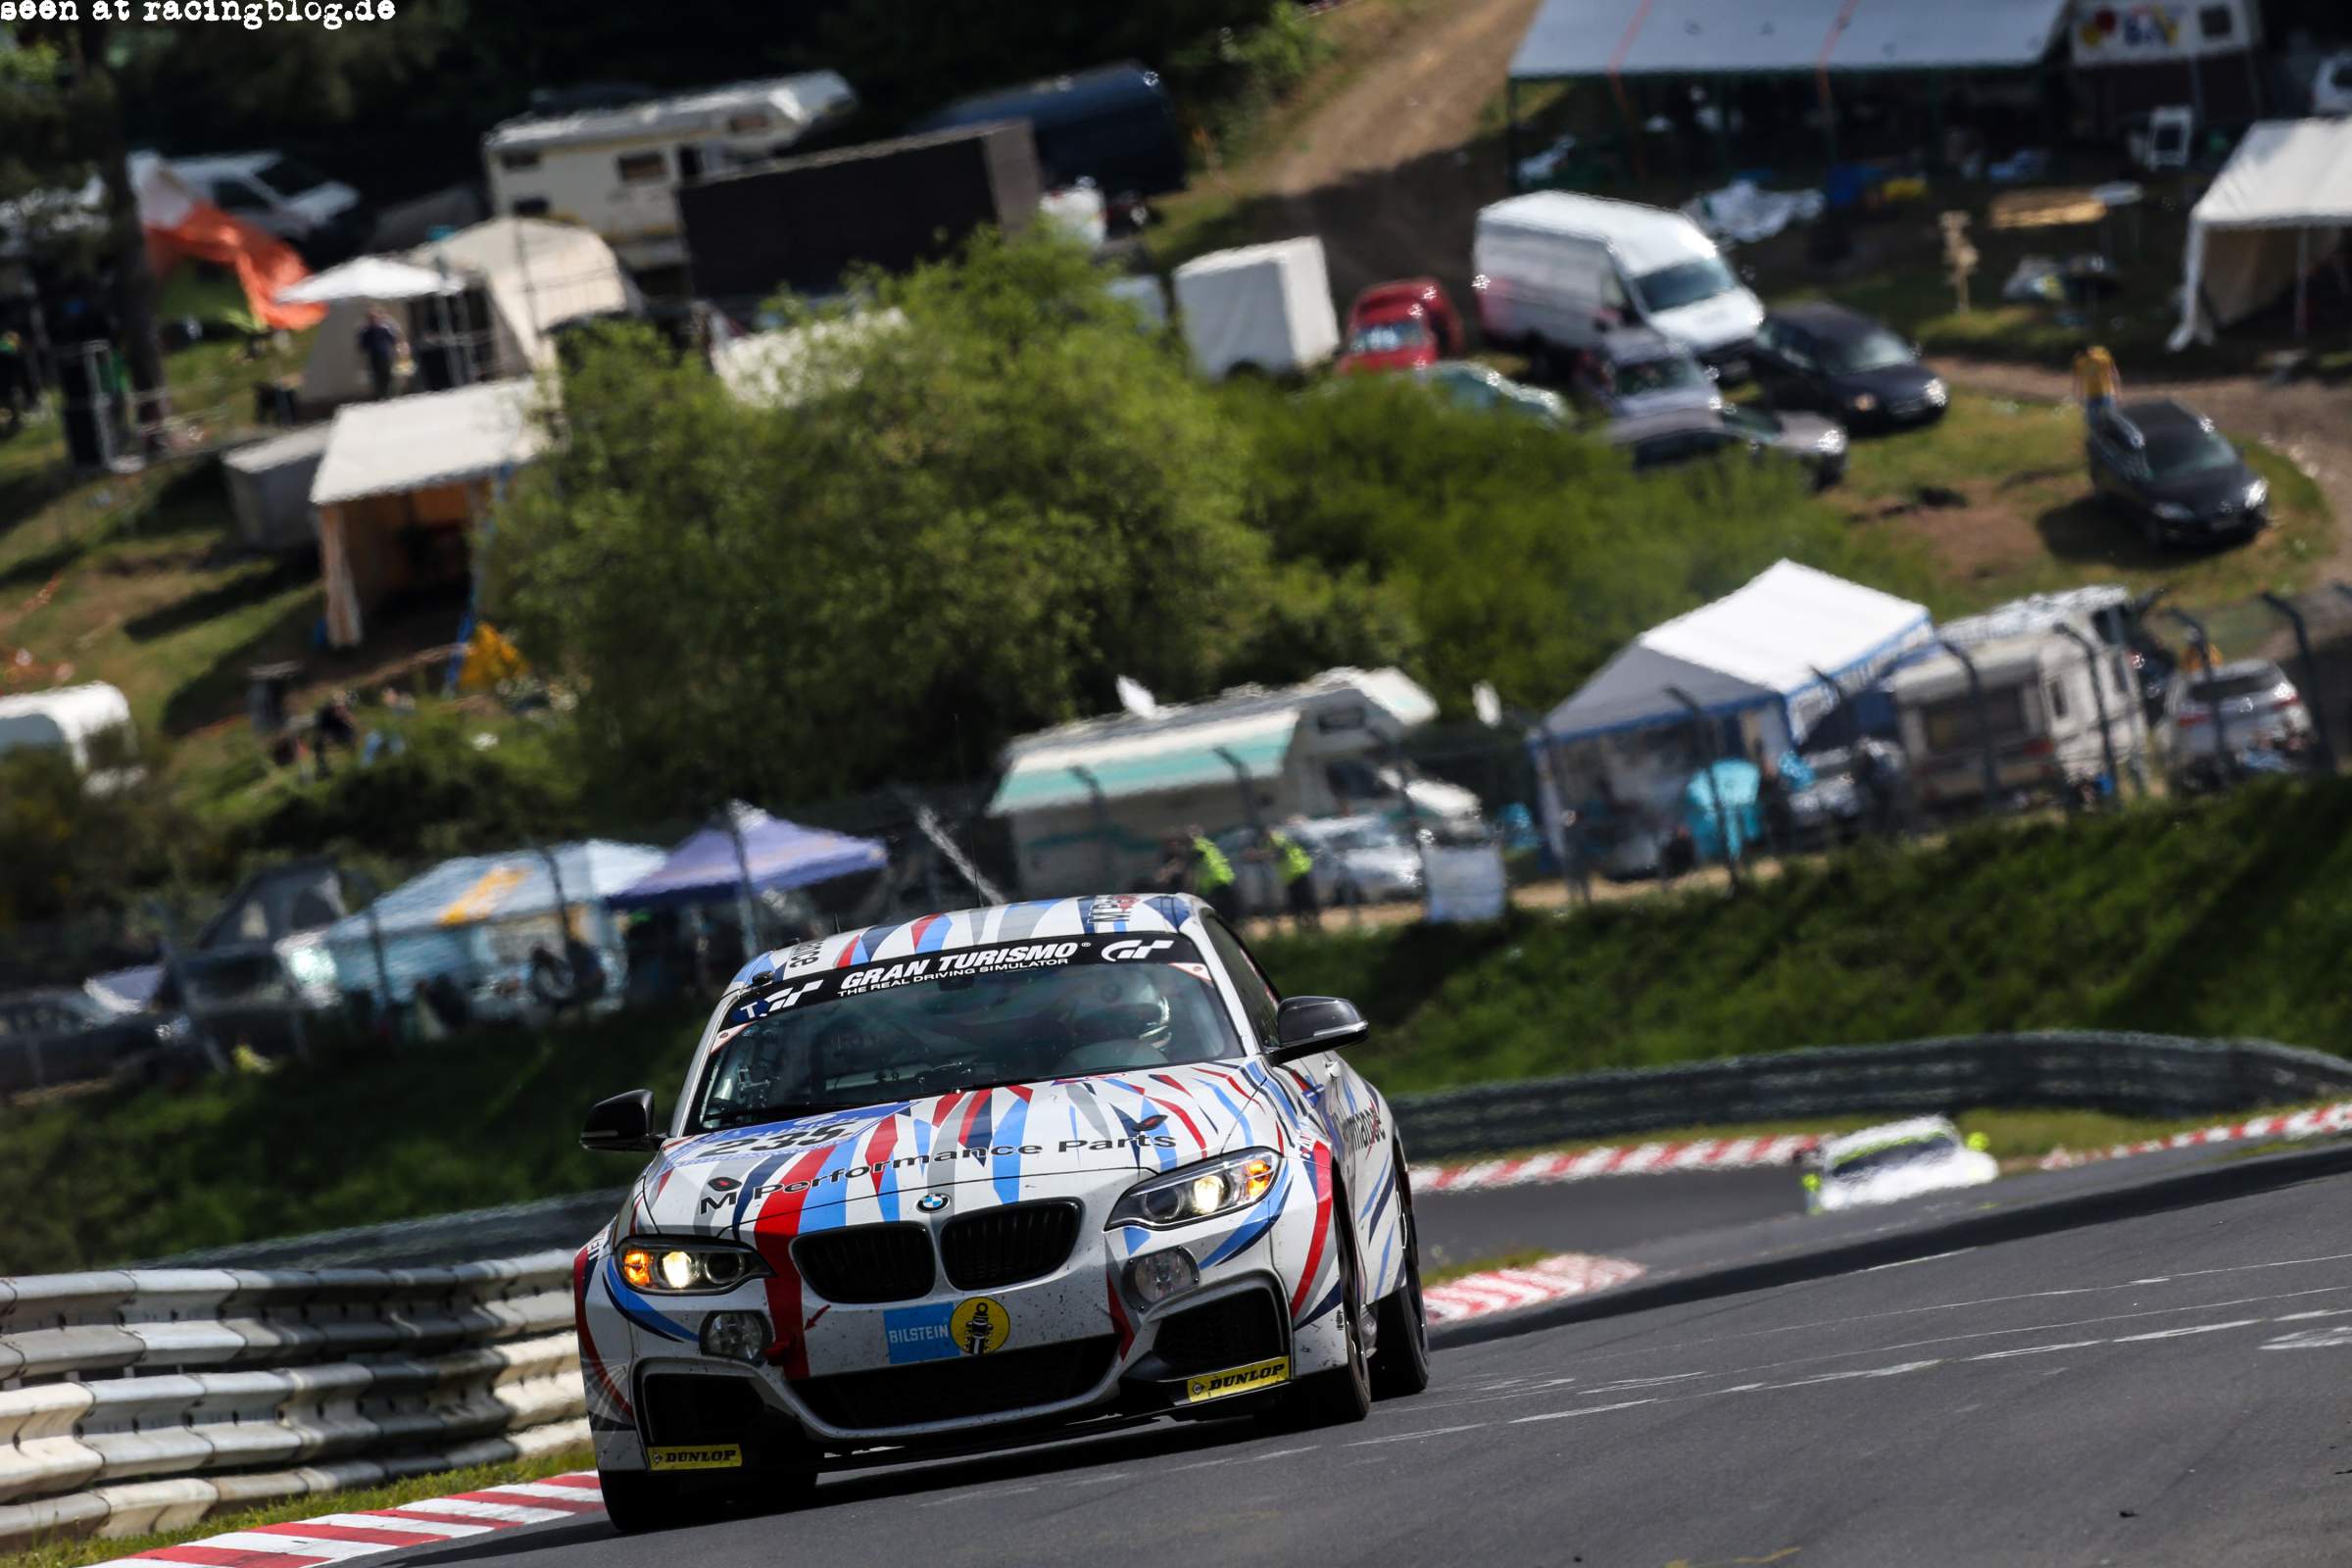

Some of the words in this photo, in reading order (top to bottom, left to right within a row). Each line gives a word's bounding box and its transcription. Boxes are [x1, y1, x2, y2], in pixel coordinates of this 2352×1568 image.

[837, 985, 868, 998] THE
[869, 979, 910, 992] REAL
[912, 967, 976, 983] DRIVING
[979, 957, 1069, 973] SIMULATOR
[840, 958, 930, 990] GRAN
[697, 1121, 857, 1158] 235
[699, 1189, 738, 1215] M
[752, 1143, 1044, 1200] Performance
[1057, 1133, 1177, 1153] Parts
[888, 1324, 950, 1344] BILSTEIN
[1207, 1363, 1286, 1391] DUNLOP
[664, 1449, 737, 1463] DUNLOP
